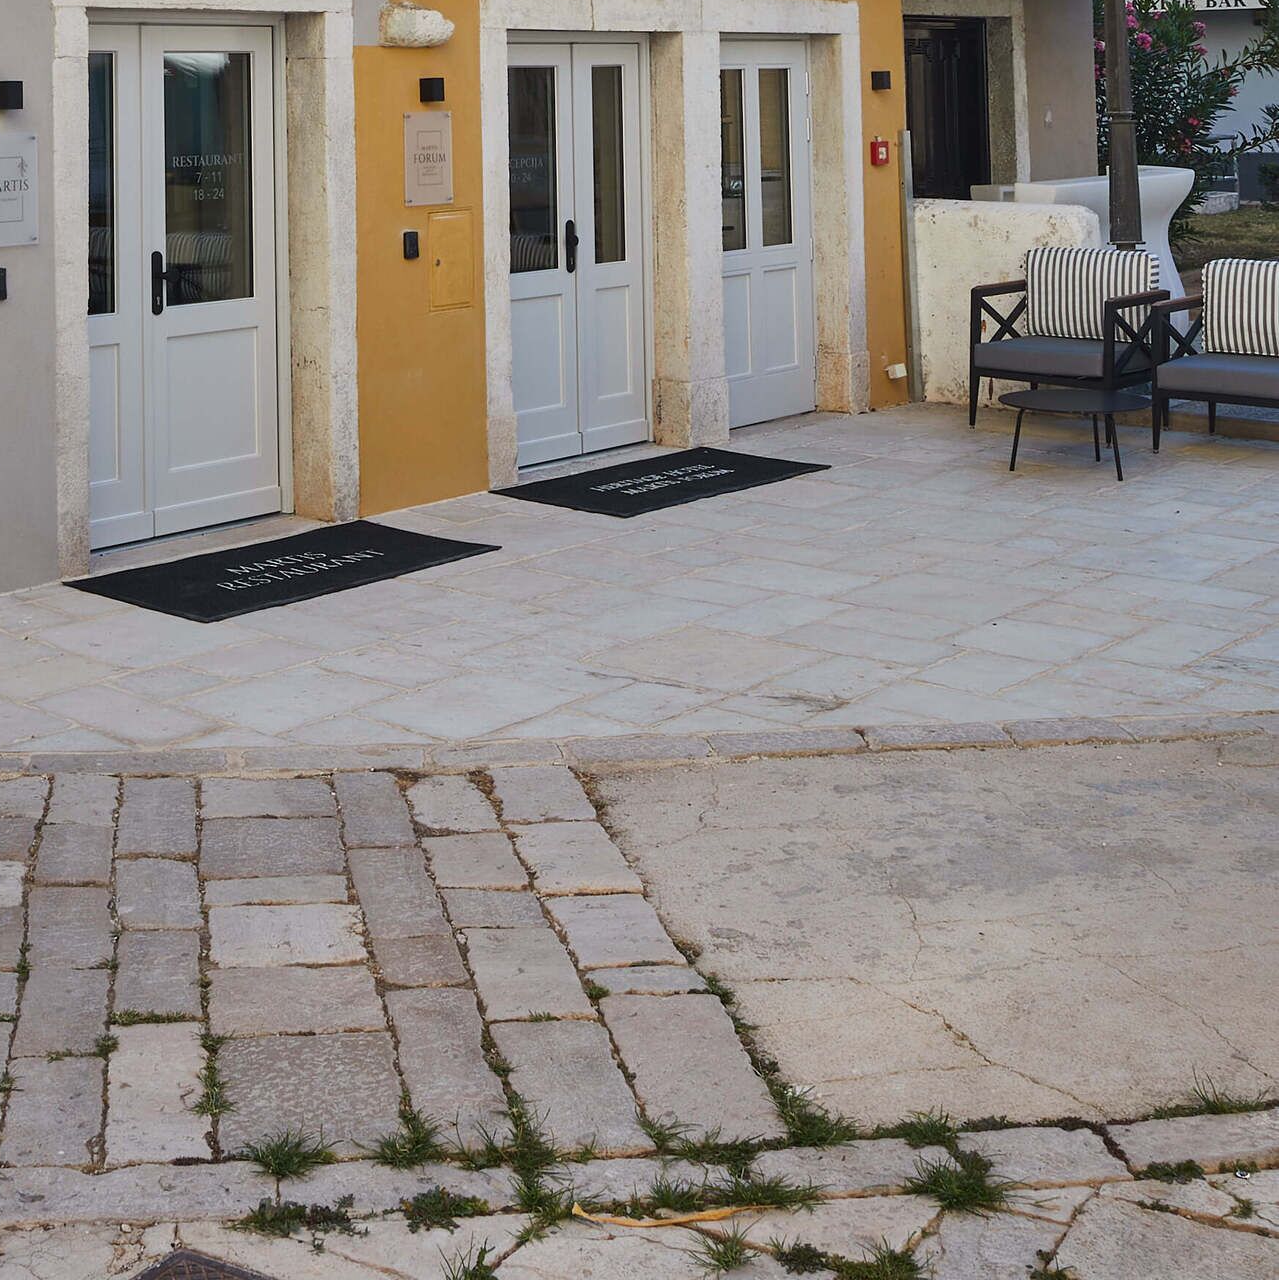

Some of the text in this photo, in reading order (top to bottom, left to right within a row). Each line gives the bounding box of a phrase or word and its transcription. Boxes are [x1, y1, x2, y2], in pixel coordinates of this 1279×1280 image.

[172, 152, 244, 168] RESTAURANT
[413, 152, 447, 164] FORUM
[216, 549, 385, 591] RESTAURANT
[225, 551, 326, 575] MARTIS
